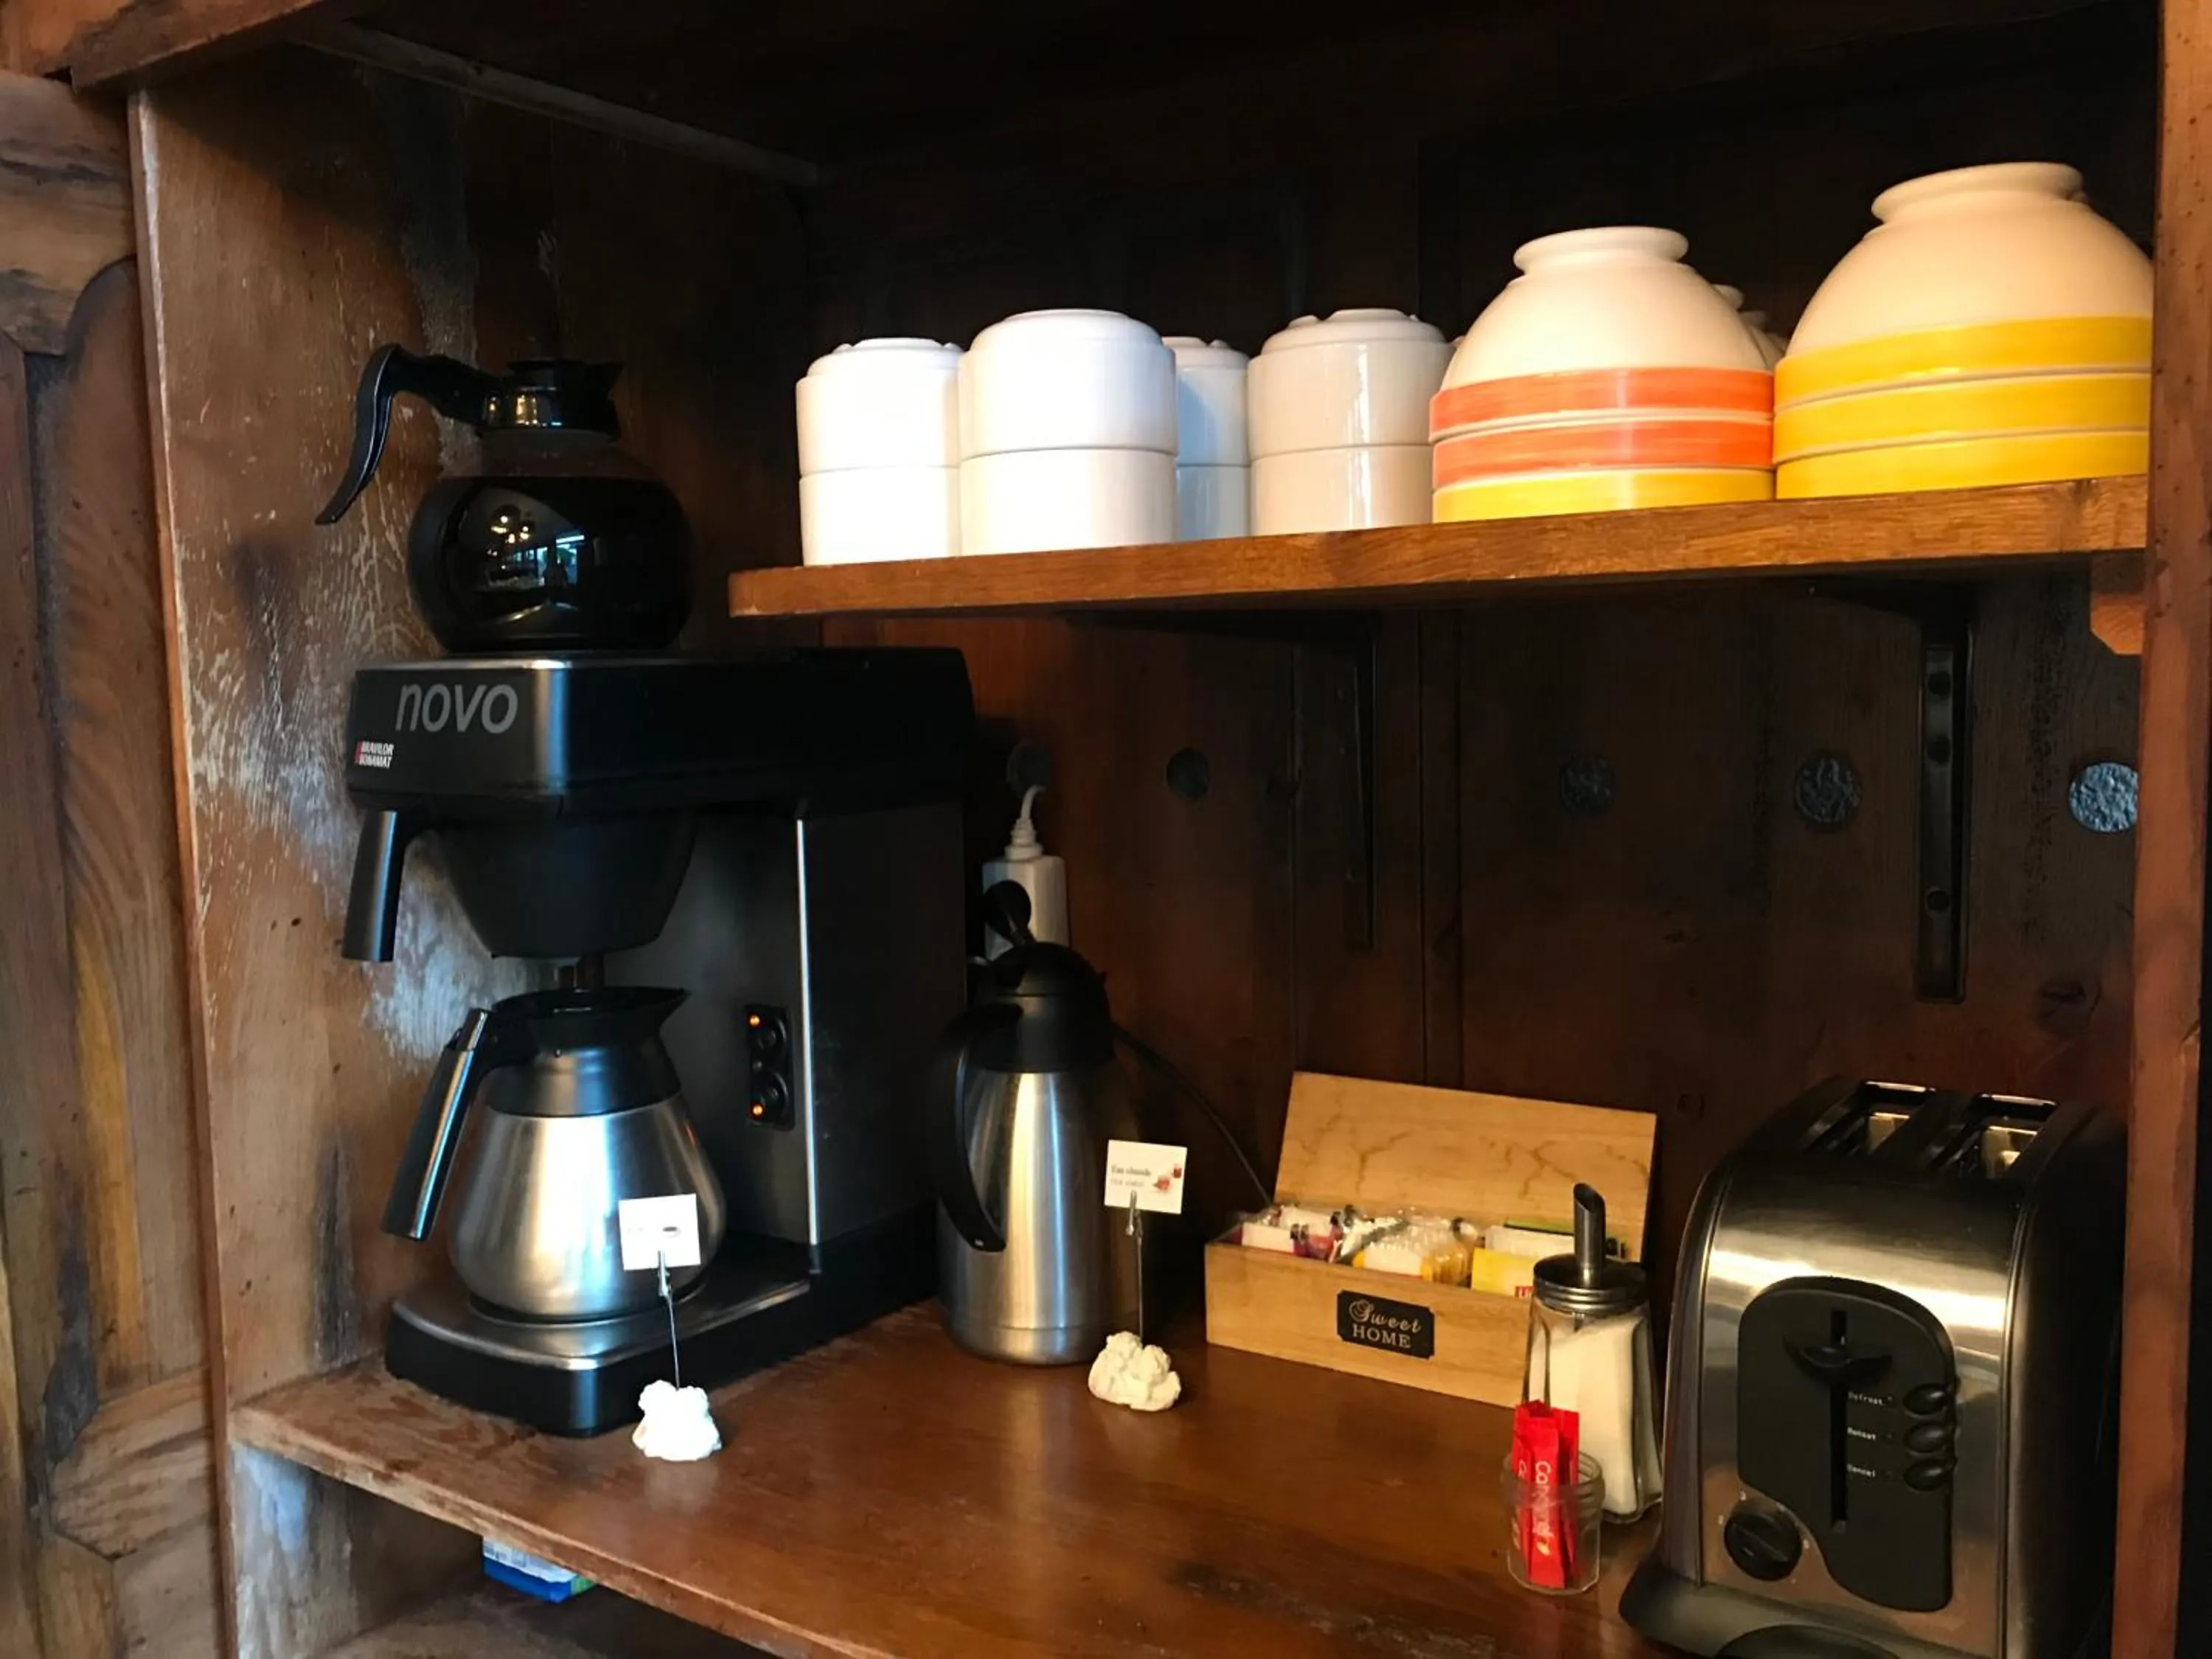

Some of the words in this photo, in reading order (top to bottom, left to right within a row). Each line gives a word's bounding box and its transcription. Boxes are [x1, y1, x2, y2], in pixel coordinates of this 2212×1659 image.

[395, 684, 518, 734] novo
[1349, 1299, 1421, 1333] Sweet
[1352, 1323, 1411, 1349] HOME
